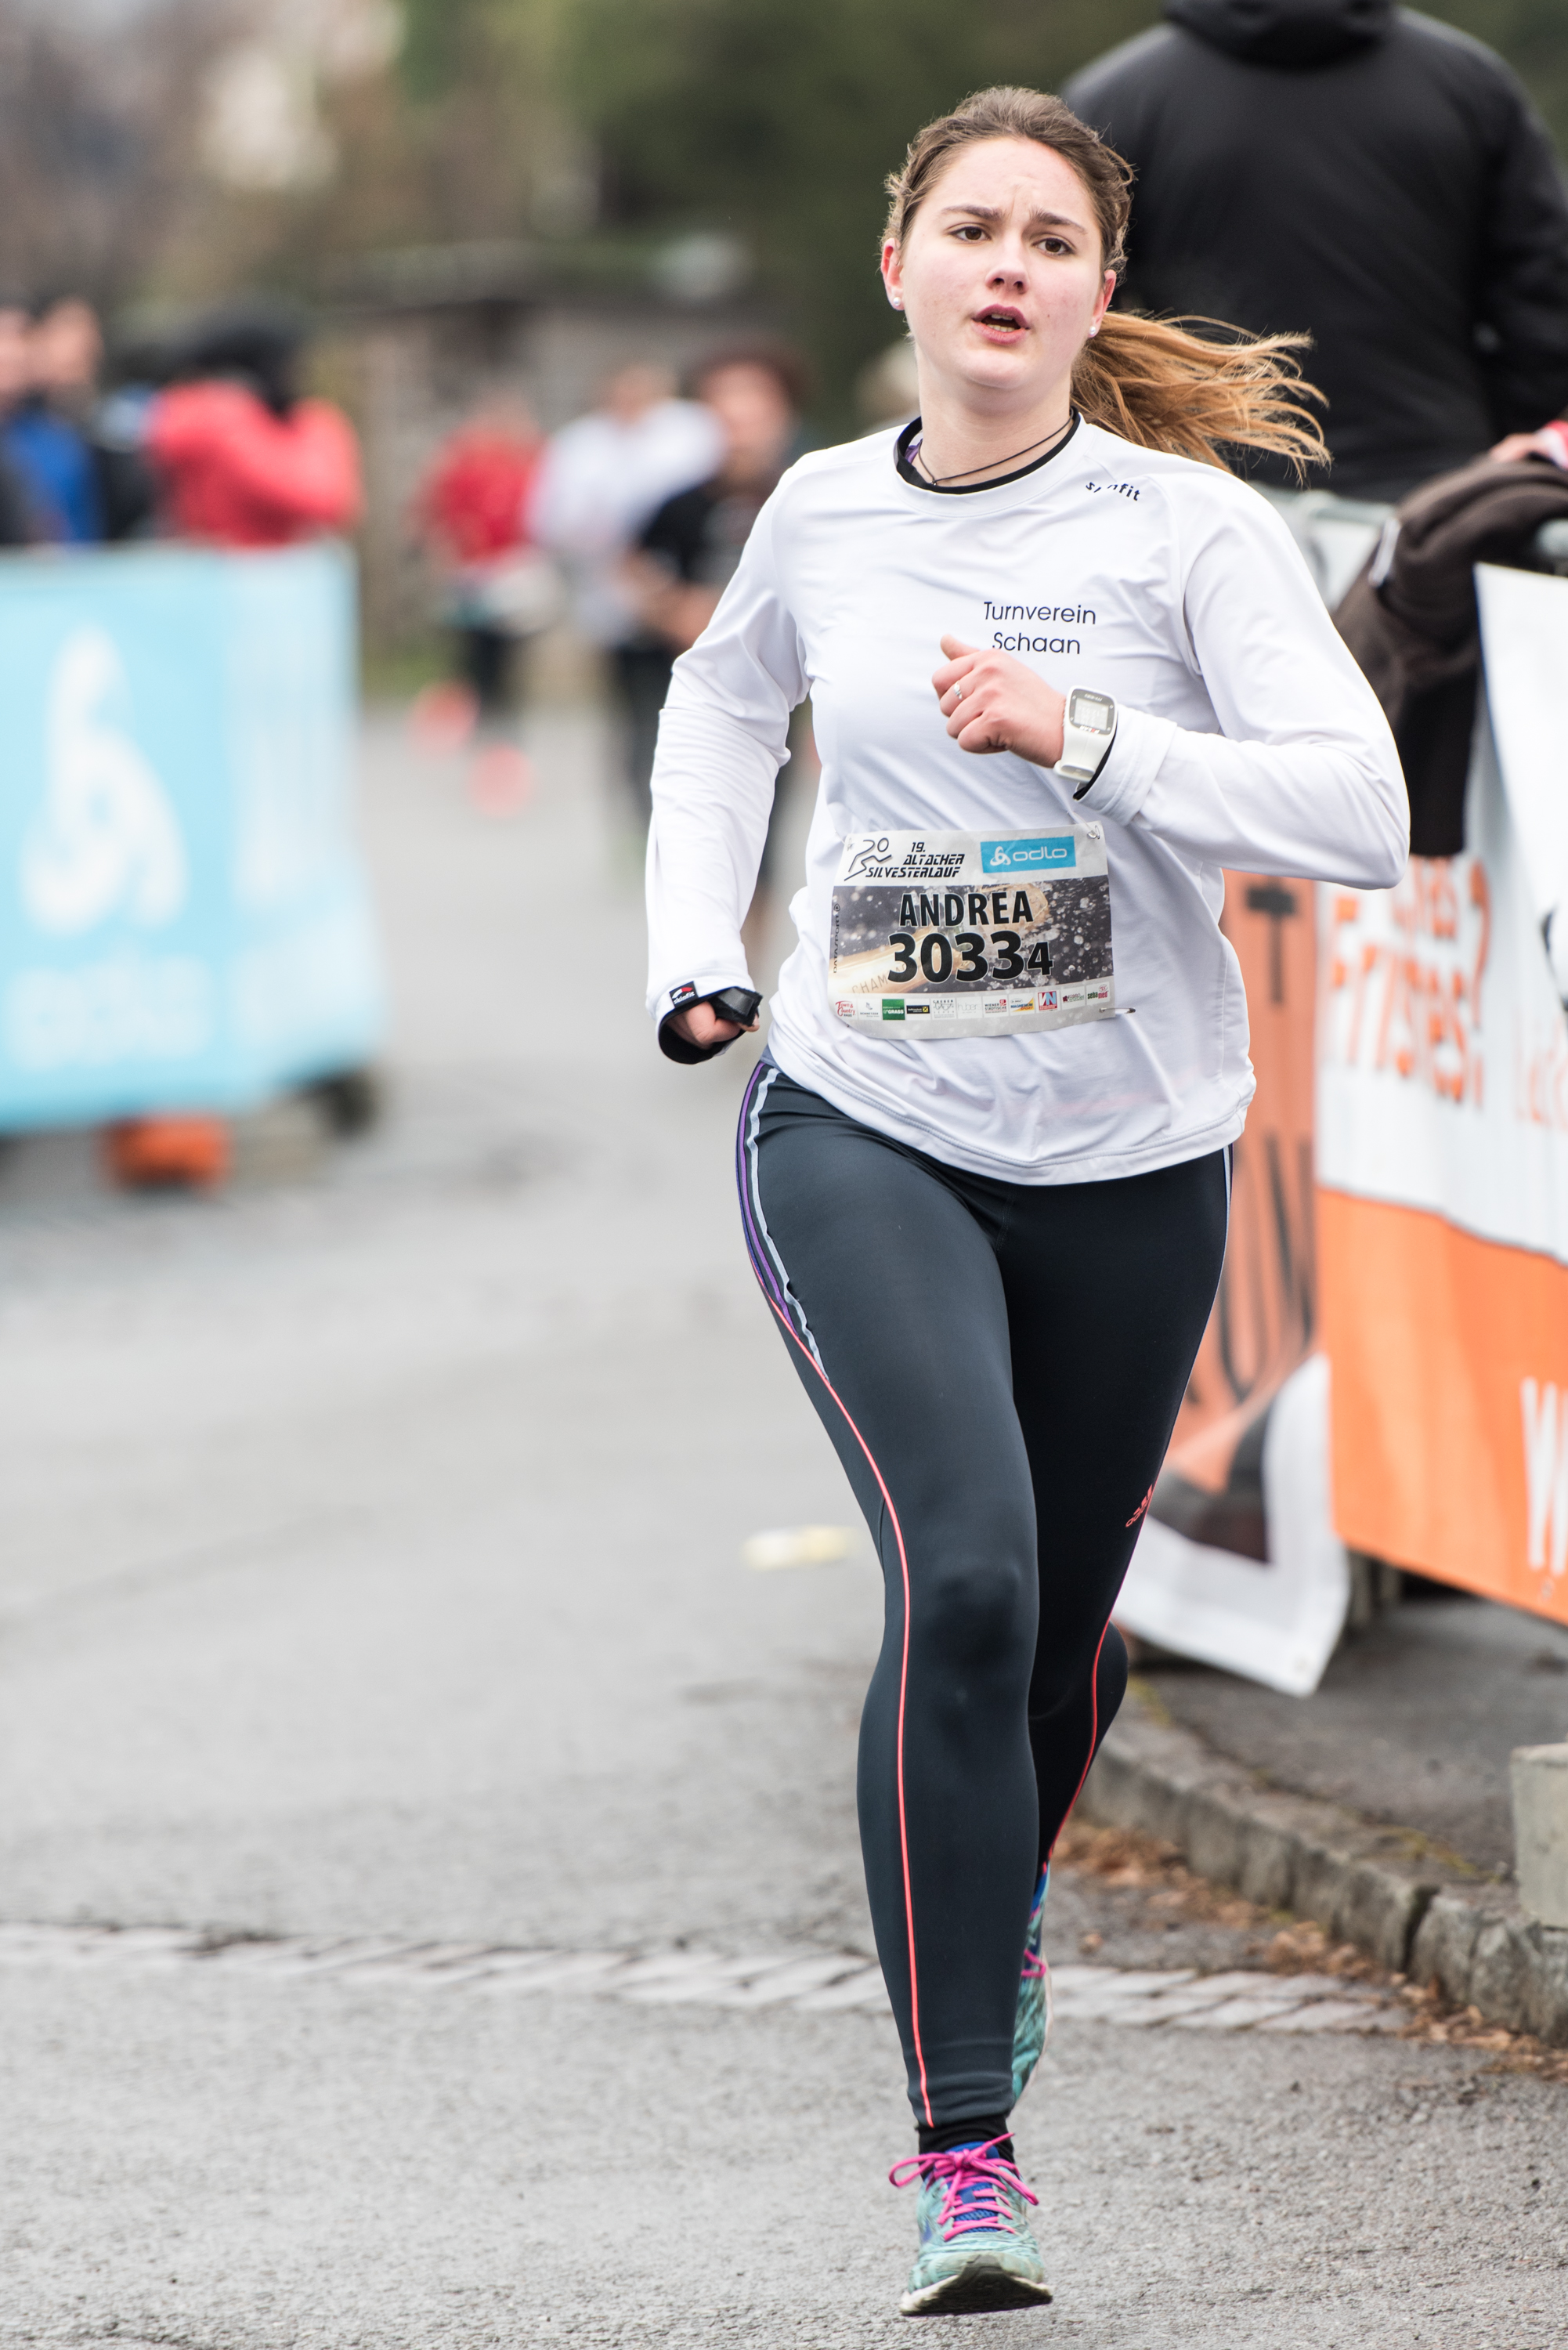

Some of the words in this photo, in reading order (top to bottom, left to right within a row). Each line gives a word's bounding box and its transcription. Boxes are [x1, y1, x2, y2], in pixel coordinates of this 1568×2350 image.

[984, 602, 1097, 624] Turnverein
[992, 631, 1081, 654] Schaan
[911, 842, 926, 853] 19.
[1013, 847, 1068, 862] odlo
[903, 854, 965, 865] ALTACHER
[865, 865, 961, 878] SILVESTERLAUF
[899, 891, 1033, 927] ANDREA
[887, 931, 1053, 984] 30334
